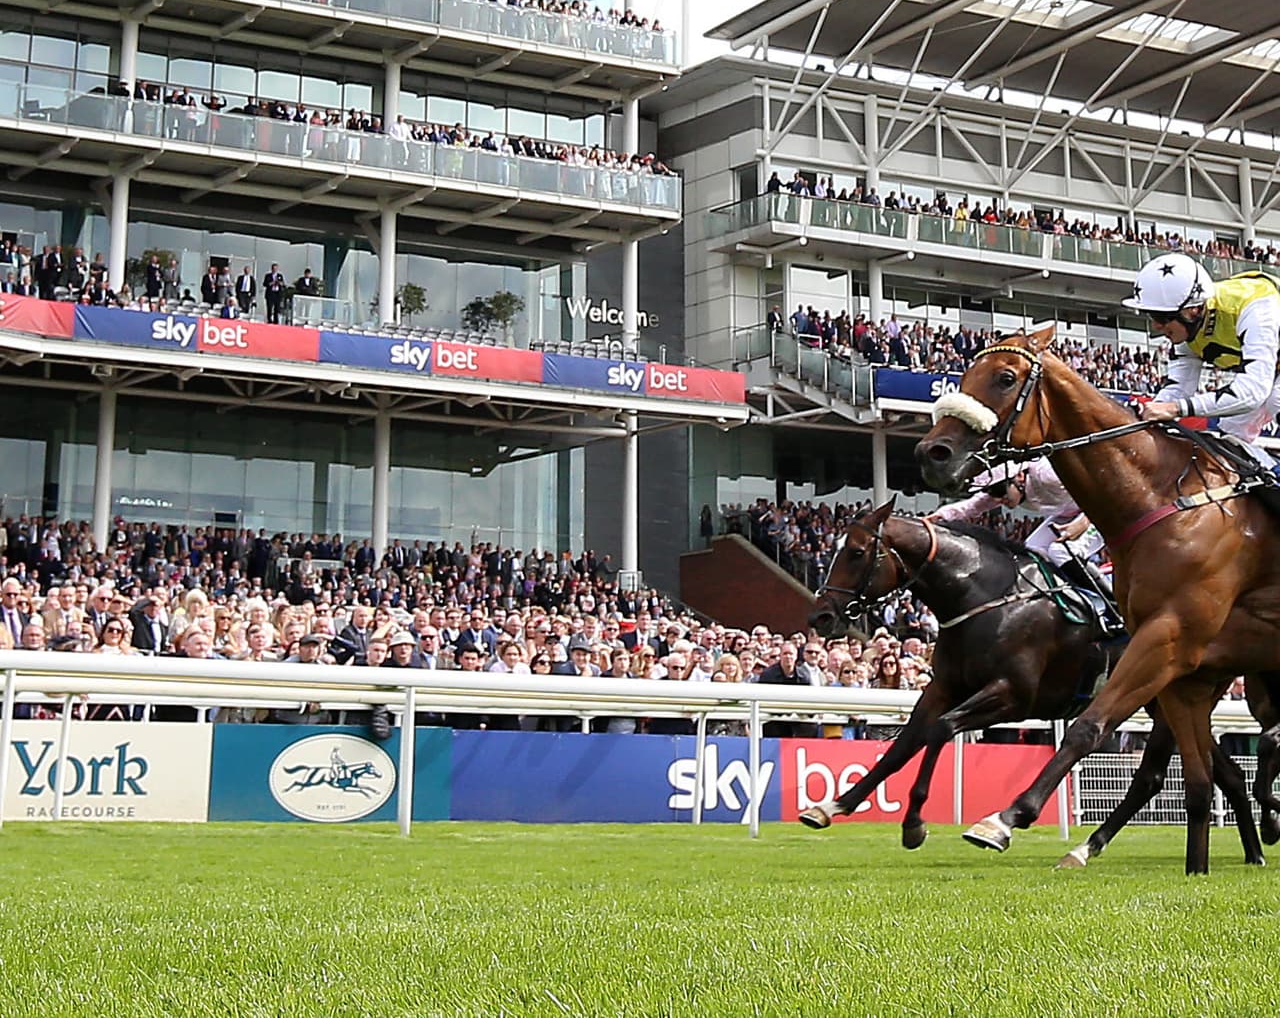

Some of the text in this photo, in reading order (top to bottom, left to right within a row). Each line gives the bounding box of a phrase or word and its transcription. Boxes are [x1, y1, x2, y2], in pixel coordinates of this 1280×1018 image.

[152, 316, 248, 348] sky bet
[390, 340, 477, 371] sky bet
[608, 362, 687, 391] sky bet
[10, 740, 149, 796] York
[668, 744, 774, 824] sky
[796, 747, 901, 813] bet
